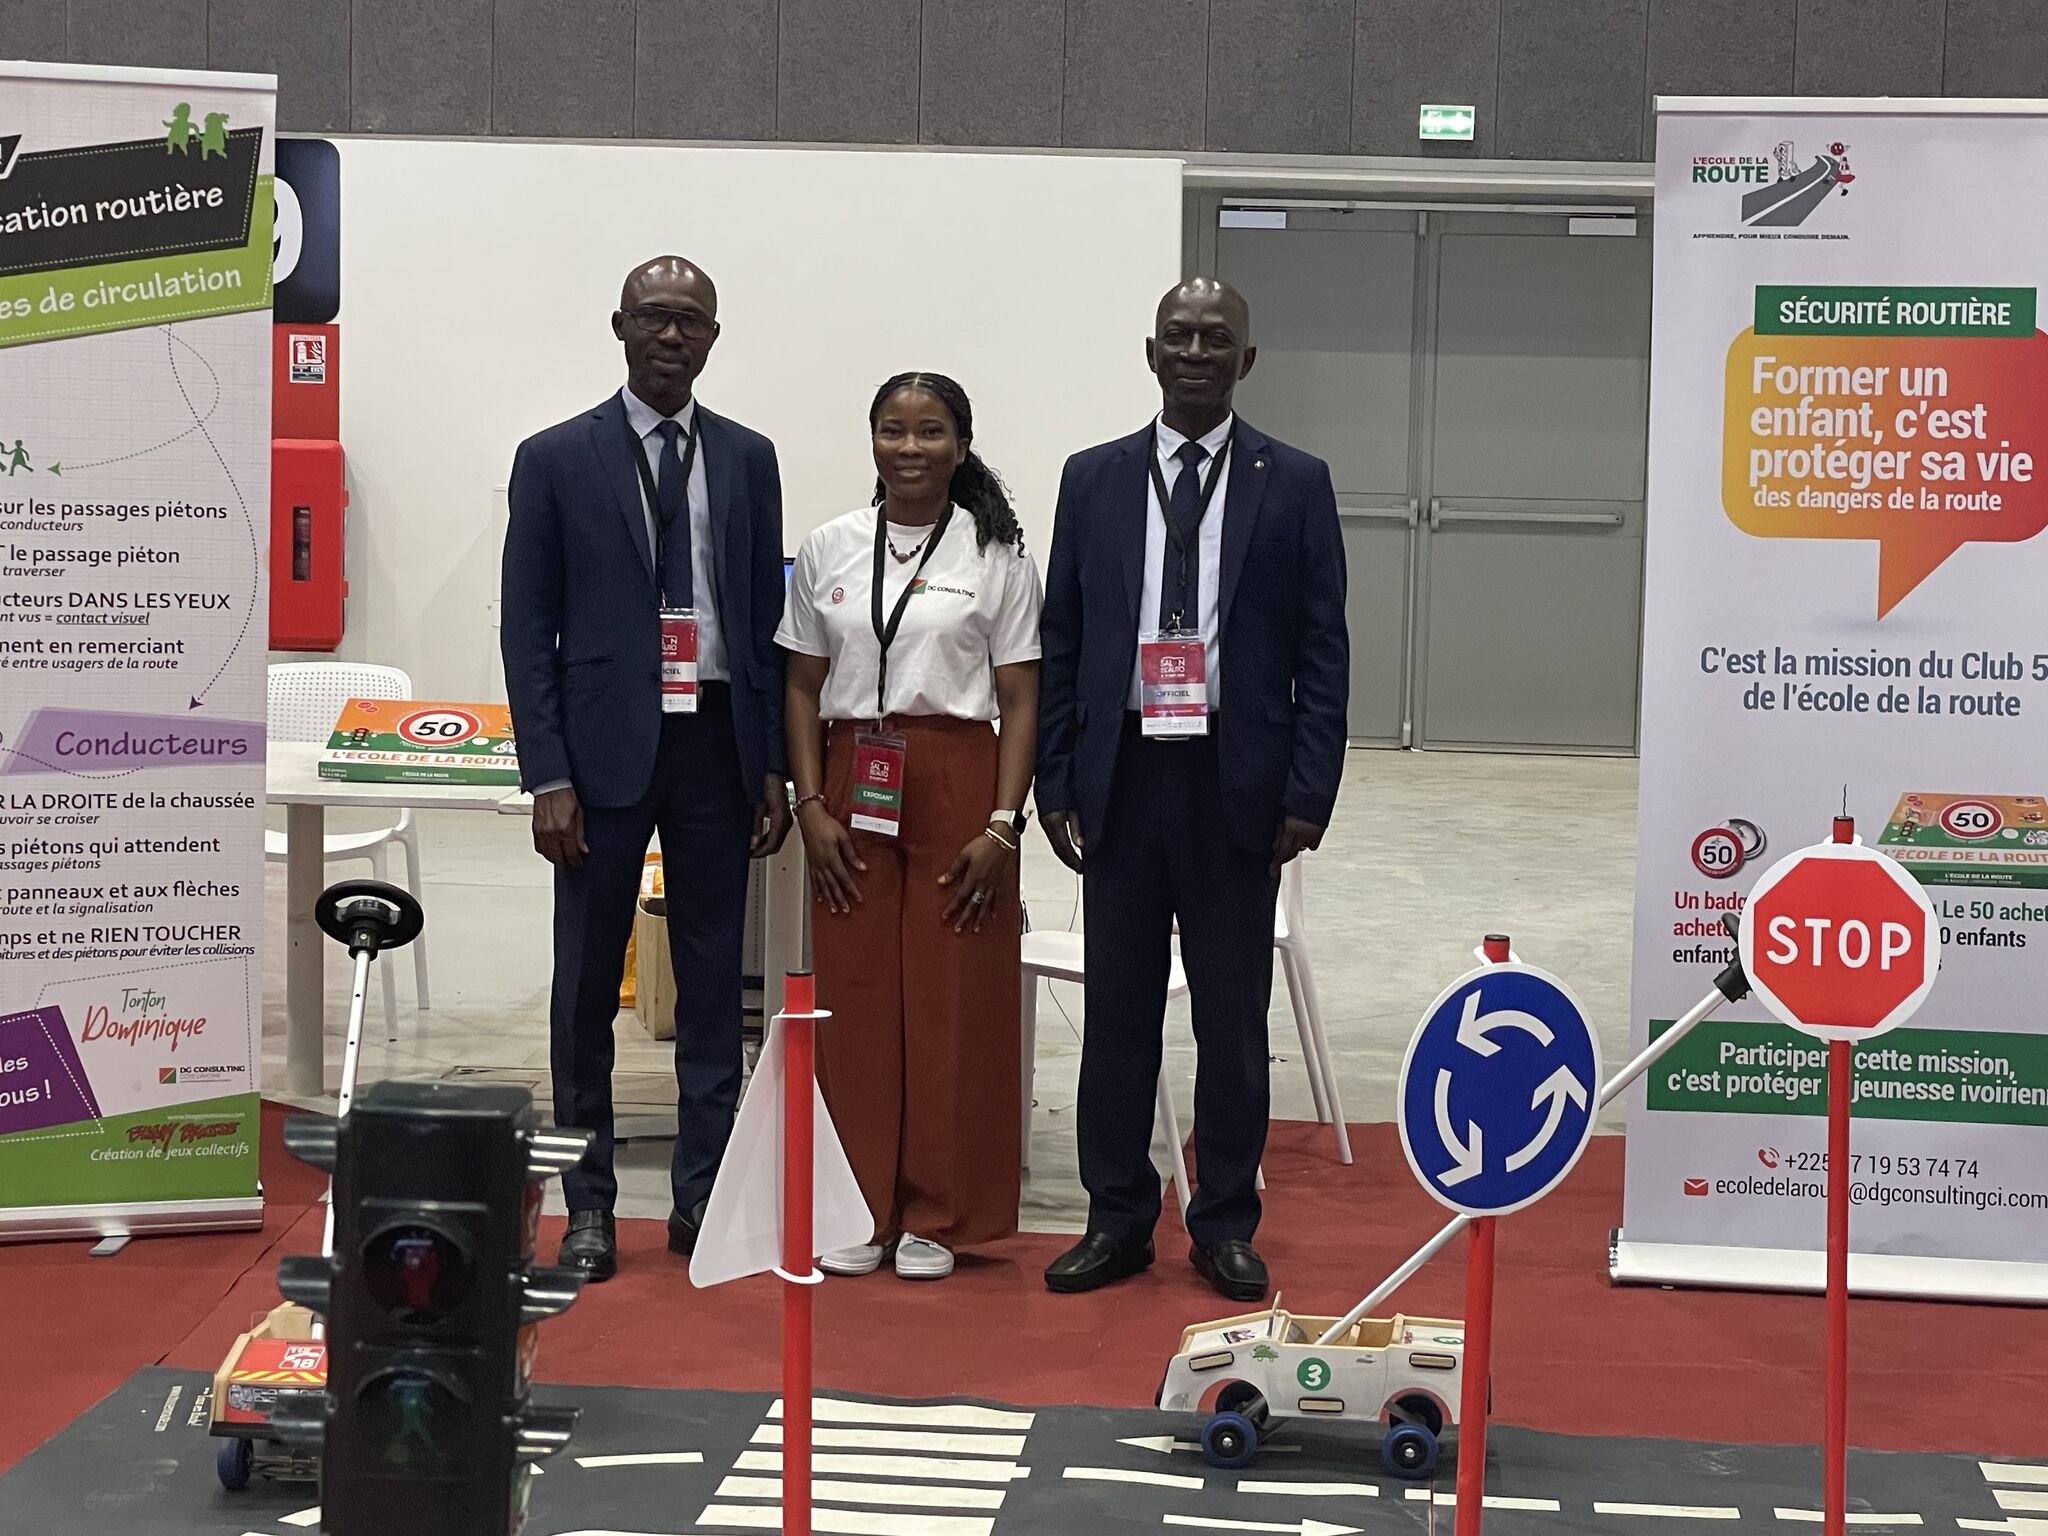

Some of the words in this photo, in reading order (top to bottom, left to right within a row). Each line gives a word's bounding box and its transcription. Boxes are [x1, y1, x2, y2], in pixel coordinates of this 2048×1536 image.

[1693, 156, 1736, 165] L'ECOLE
[1738, 157, 1753, 165] DE
[1755, 157, 1769, 165] LA
[1692, 165, 1769, 183] ROUTE
[95, 183, 224, 222] routière
[39, 287, 75, 313] de
[83, 267, 242, 307] circulation
[1779, 295, 1890, 325] SÉCURITÉ
[1896, 296, 2011, 326] ROUTIÈRE
[1753, 356, 1889, 396] Former
[1899, 366, 1948, 397] un
[1750, 396, 1883, 445] enfant,
[1895, 400, 1987, 440] c'est
[1749, 438, 1911, 489] protéger
[1920, 451, 1965, 481] sa
[1976, 440, 2033, 482] vie
[1753, 484, 1791, 506] des
[1797, 485, 1882, 513] dangers
[1887, 486, 1914, 509] de
[1920, 487, 1938, 510] la
[1945, 490, 2001, 511] route
[30, 498, 55, 515] les
[61, 503, 150, 521] passages
[155, 501, 227, 521] piétons
[1, 517, 83, 531] conducteurs
[11, 544, 27, 561] le
[32, 548, 112, 566] passage
[117, 546, 180, 567] piéton
[2, 565, 66, 577] traverser
[0, 592, 63, 607] cteurs
[68, 592, 128, 608] DANS
[133, 592, 171, 608] LES
[174, 593, 231, 610] YEUX
[18, 613, 42, 623] vus
[56, 613, 108, 624] contact
[112, 612, 150, 624] visuel
[49, 641, 72, 653] en
[78, 637, 184, 654] remerciant
[12, 657, 49, 669] entre
[52, 659, 104, 672] usagers
[107, 657, 124, 669] de
[126, 657, 139, 669] la
[142, 658, 178, 669] route
[1700, 646, 1766, 674] C'est
[1774, 646, 1797, 675] la
[1805, 648, 1911, 678] mission
[1919, 650, 1953, 679] du
[1961, 651, 2023, 681] Club
[1743, 682, 1775, 710] de
[1783, 683, 1869, 712] l'école
[1877, 684, 1910, 713] de
[1918, 686, 1941, 714] la
[1949, 691, 2021, 717] route
[414, 721, 462, 737] 50
[55, 731, 248, 756] Conducteurs
[332, 750, 401, 762] L'ÉCOLE
[405, 753, 433, 762] DE
[434, 754, 456, 764] LA
[11, 794, 36, 809] LA
[42, 793, 118, 809] DROITE
[122, 792, 145, 808] de
[150, 792, 166, 808] la
[170, 791, 255, 808] chaussée
[863, 790, 894, 802] EXPOSANT
[36, 816, 51, 825] se
[54, 813, 100, 825] croiser
[1953, 812, 1989, 828] 50
[11, 837, 84, 859] piétons
[89, 837, 118, 858] qui
[124, 836, 220, 853] attendent
[1703, 845, 1732, 865] 50
[1952, 850, 1975, 861] DE
[1979, 851, 1999, 862] LA
[0, 861, 48, 873] ssages
[51, 858, 101, 872] piétons
[7, 887, 104, 904] panneaux
[109, 883, 128, 898] et
[133, 885, 169, 897] aux
[172, 881, 240, 897] flèches
[1675, 891, 1699, 909] Un
[36, 905, 49, 915] et
[52, 903, 65, 915] la
[68, 901, 153, 917] signalisation
[1943, 900, 1965, 918] Le
[1970, 901, 1994, 920] 50
[37, 930, 57, 945] et
[62, 931, 85, 944] ne
[90, 927, 139, 943] RIEN
[143, 925, 241, 941] TOUCHER
[1766, 915, 1912, 971] STOP
[1956, 927, 2026, 947] enfants
[38, 949, 50, 960] et
[52, 947, 73, 959] des
[74, 946, 119, 962] piétons
[119, 948, 148, 960] pour
[149, 944, 184, 956] éviter
[185, 944, 201, 955] les
[202, 943, 255, 955] collisions
[121, 988, 166, 1014] Tonton
[81, 1005, 207, 1052] Dominique
[193, 1065, 246, 1073] CONSULTING
[1854, 1049, 1913, 1071] cette
[1918, 1049, 2015, 1080] mission,
[1667, 1068, 1721, 1092] c'est
[1726, 1071, 1822, 1100] protéger
[1850, 1073, 1955, 1103] jeunesse
[1961, 1077, 2048, 1106] ivoirien
[90, 1147, 143, 1161] Création
[146, 1146, 162, 1158] de
[165, 1147, 196, 1161] jeux
[195, 1141, 249, 1159] collectifs
[1869, 1155, 1891, 1175] 19
[1897, 1157, 1921, 1176] 53
[1926, 1158, 1950, 1177] 74
[1955, 1159, 1979, 1178] 74
[292, 1358, 315, 1368] 18
[1304, 1364, 1322, 1386] 3
